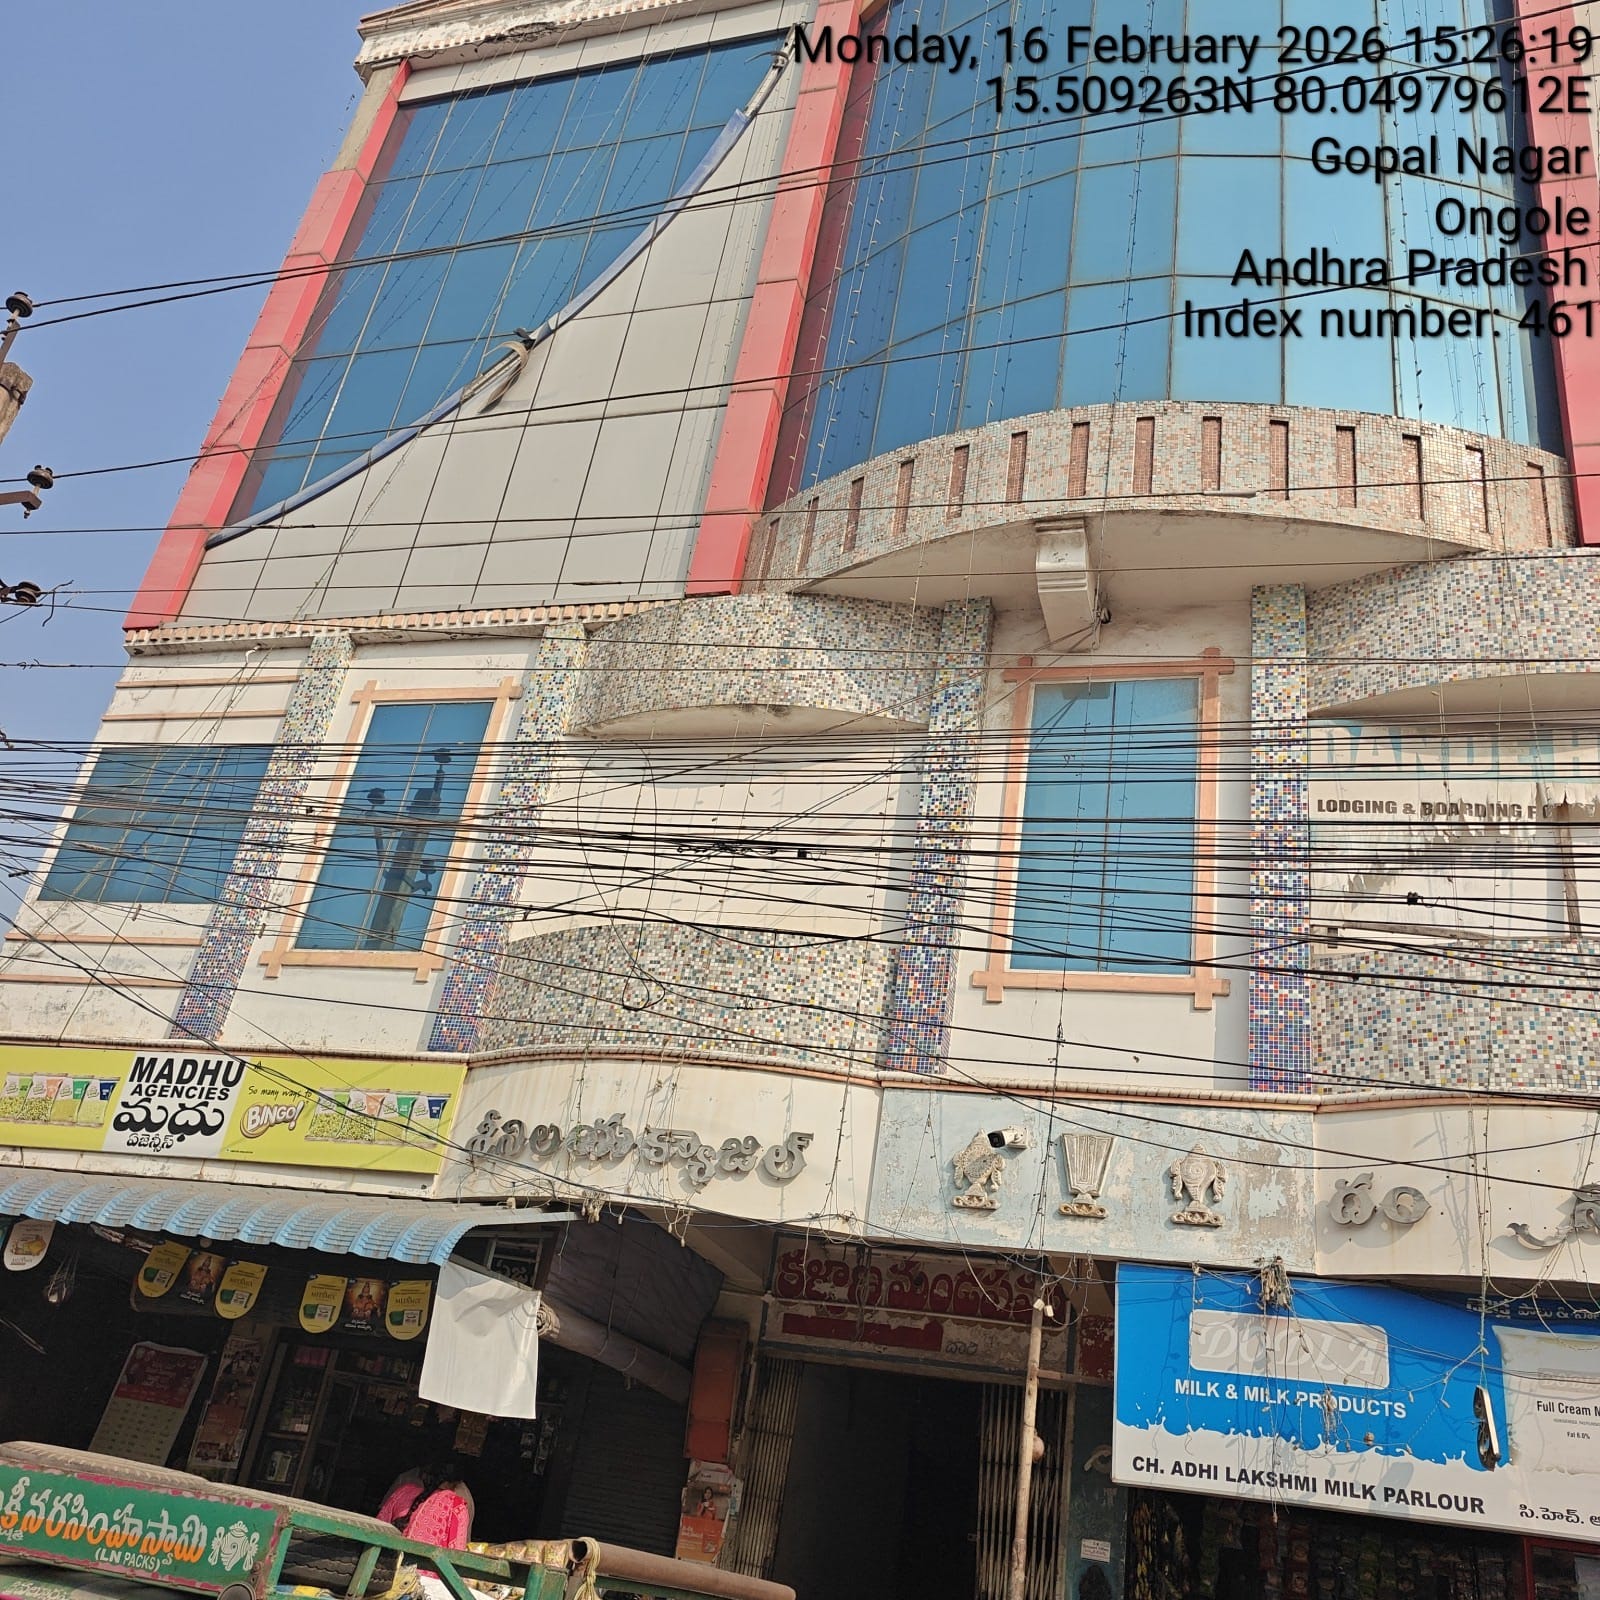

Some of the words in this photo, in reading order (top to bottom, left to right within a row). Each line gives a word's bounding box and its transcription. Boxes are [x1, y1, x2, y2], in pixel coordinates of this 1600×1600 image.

[1317, 799, 1397, 815] LODGING
[1402, 802, 1416, 815] &
[1420, 802, 1523, 819] BOARDING
[128, 1056, 246, 1088] MADHU
[130, 1083, 231, 1101] AGENCIES
[248, 1086, 260, 1096] So
[261, 1088, 279, 1100] many
[112, 1097, 225, 1142] మధు
[246, 1100, 304, 1130] BINGO!
[1199, 1323, 1378, 1376] DODLA
[1174, 1379, 1221, 1399] MILK
[1225, 1384, 1239, 1400] &
[1244, 1386, 1290, 1407] MILK
[1295, 1391, 1407, 1419] PRODUCTS
[1537, 1401, 1555, 1413] Full
[1558, 1402, 1591, 1417] Cream
[1132, 1456, 1165, 1475] CH.
[1171, 1461, 1218, 1481] ADHI
[1225, 1466, 1317, 1494] LAKSHMI
[1324, 1479, 1377, 1501] MILK
[1383, 1487, 1486, 1515] PARLOUR
[95, 1546, 122, 1563] (LN
[123, 1551, 162, 1572] PACKS)
